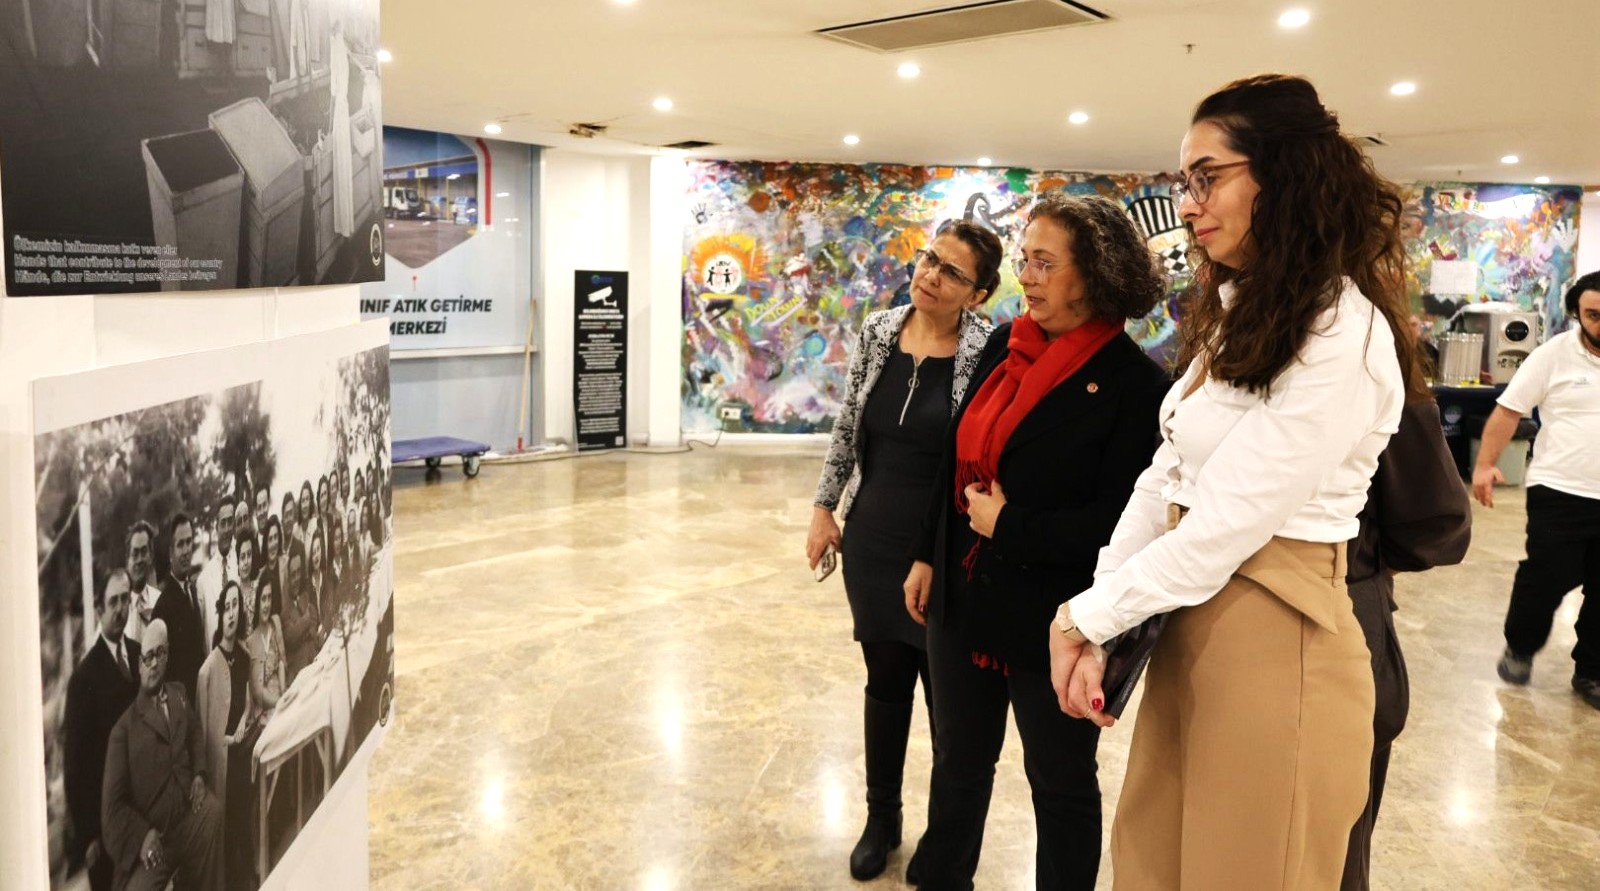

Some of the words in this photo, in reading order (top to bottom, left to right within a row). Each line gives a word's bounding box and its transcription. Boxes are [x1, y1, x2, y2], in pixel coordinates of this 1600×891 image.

[14, 252, 47, 267] Hands
[47, 254, 67, 268] that
[68, 255, 113, 268] contribute
[114, 257, 122, 268] to
[123, 257, 136, 268] the
[137, 257, 181, 270] development
[182, 257, 190, 268] of
[200, 258, 223, 270] country
[14, 270, 50, 285] Hände,
[51, 270, 67, 283] die
[67, 272, 83, 283] zur
[84, 270, 134, 285] Entwicklung
[360, 299, 390, 314] INIF
[393, 299, 428, 313] ATIK
[430, 294, 493, 313] GETİRME
